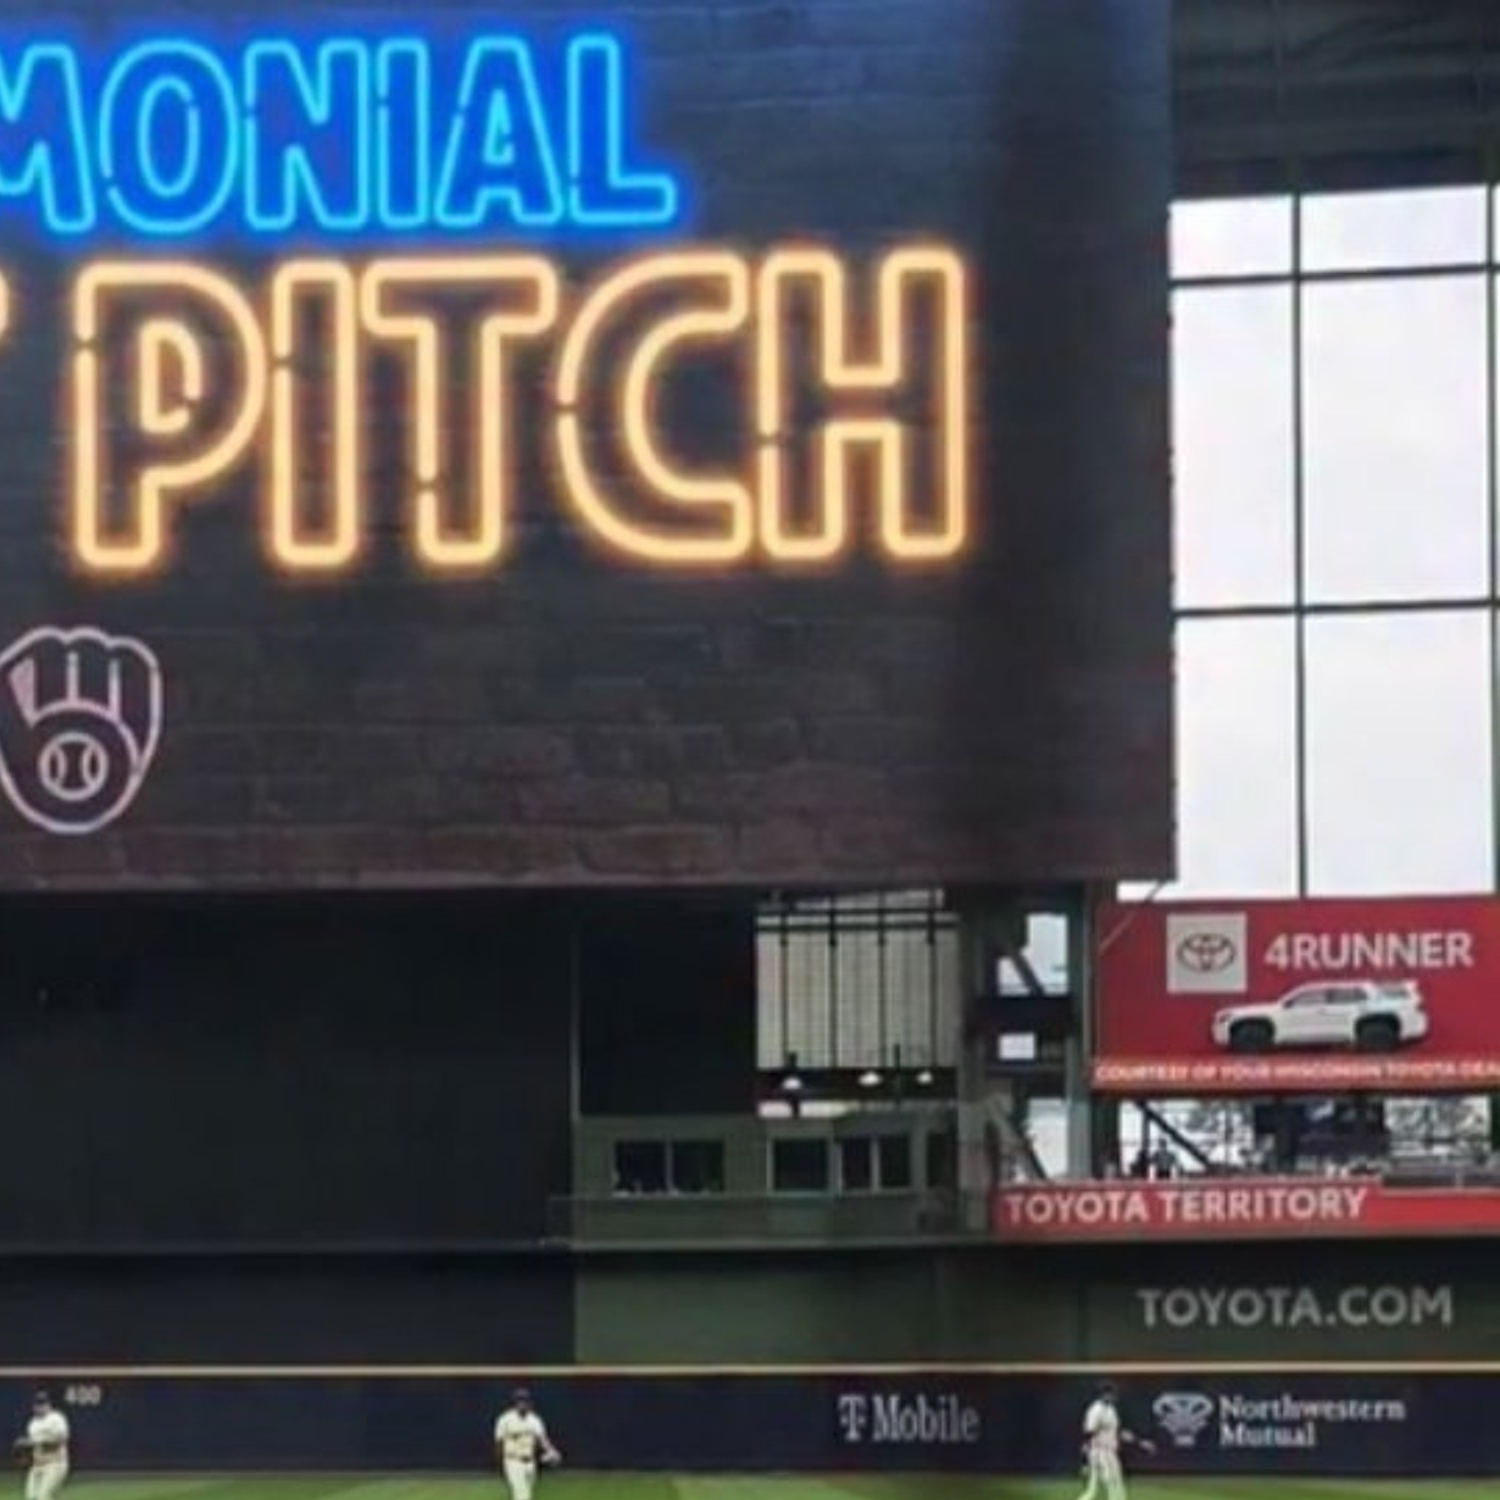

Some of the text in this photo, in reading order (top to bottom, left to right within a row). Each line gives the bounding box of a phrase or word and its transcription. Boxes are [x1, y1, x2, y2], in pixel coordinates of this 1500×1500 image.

[73, 246, 968, 572] PITCH
[1264, 930, 1474, 969] 4RUNNER
[1007, 1187, 1367, 1224] TOYOTA TERRITORY
[1137, 1287, 1453, 1326] TOYOTA.COM
[1220, 1396, 1406, 1421] Northwestern
[1220, 1422, 1317, 1448] Mutual
